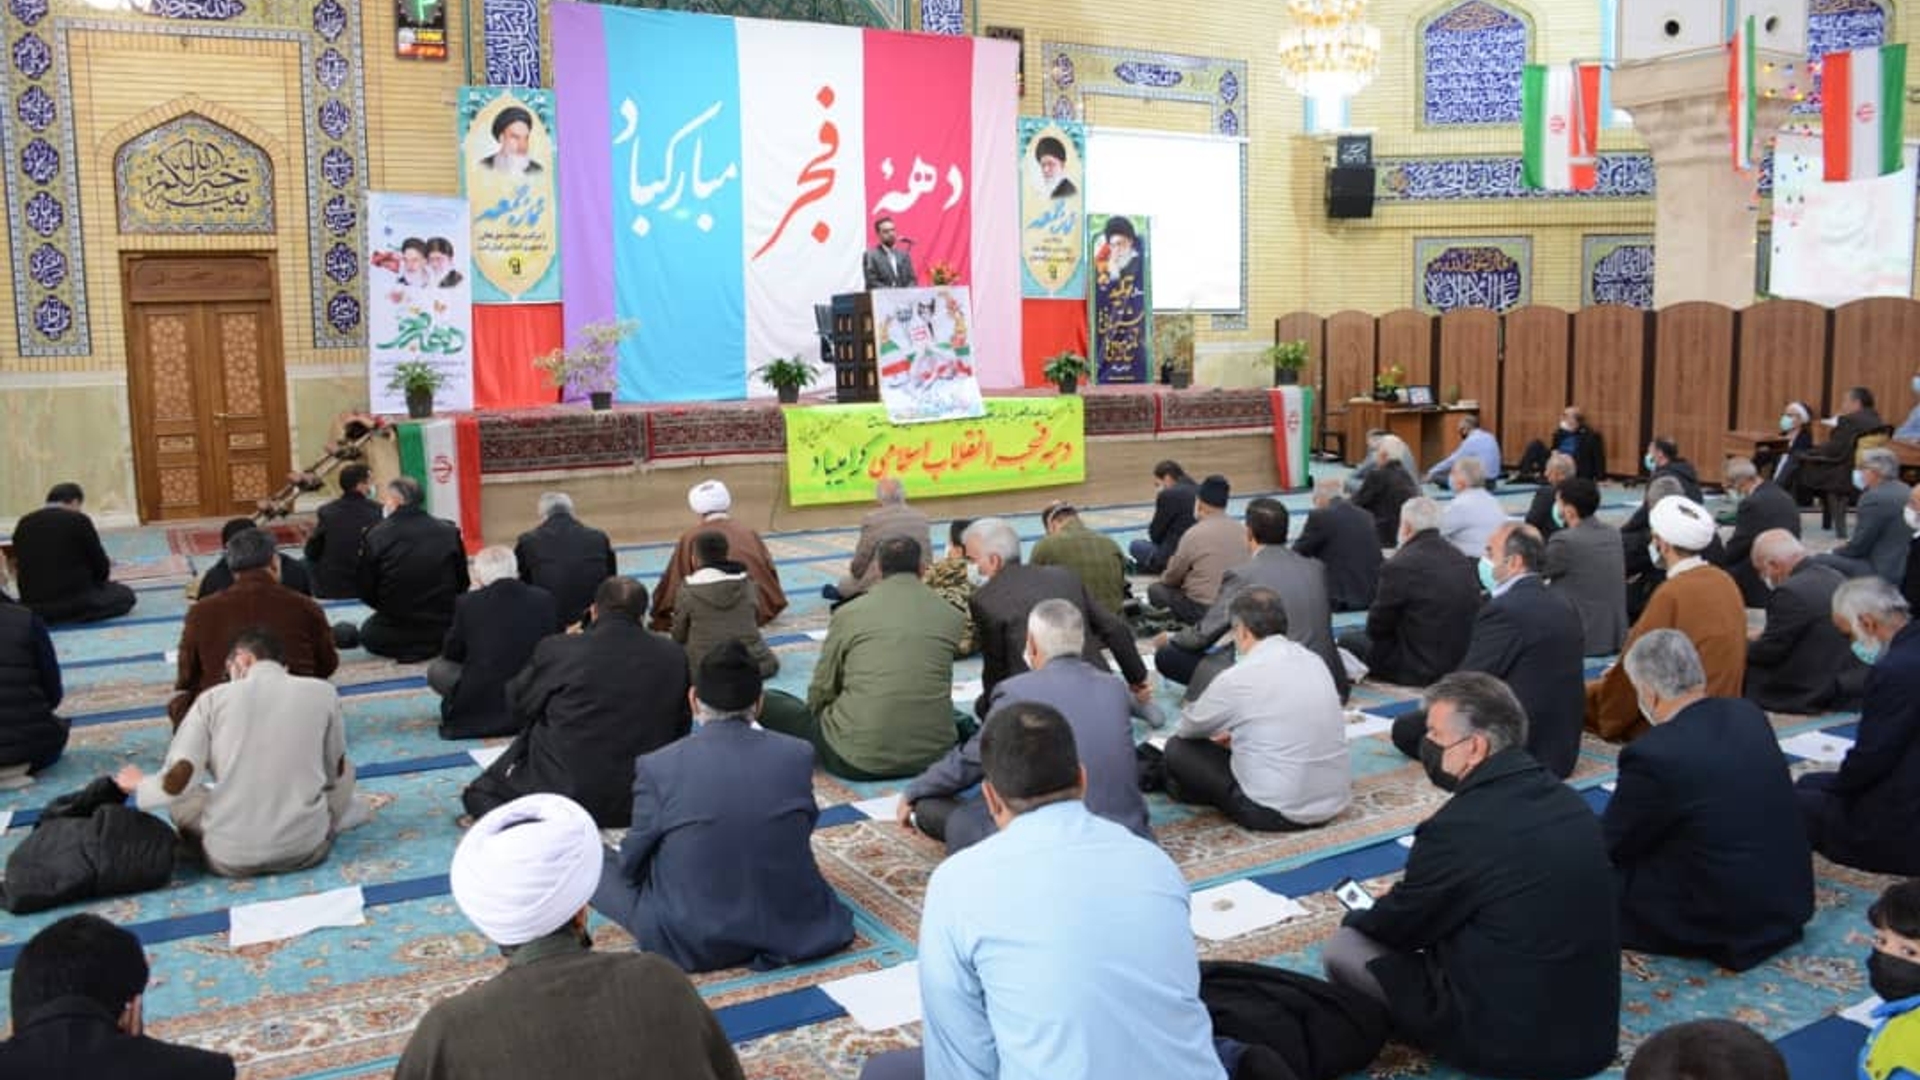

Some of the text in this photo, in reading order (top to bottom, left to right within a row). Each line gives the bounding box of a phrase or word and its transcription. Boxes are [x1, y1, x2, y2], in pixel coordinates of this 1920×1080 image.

[613, 98, 738, 237] مبارکباد
[752, 86, 840, 261] فجر
[868, 439, 929, 479] اسلامی
[923, 429, 993, 482] انقلاب
